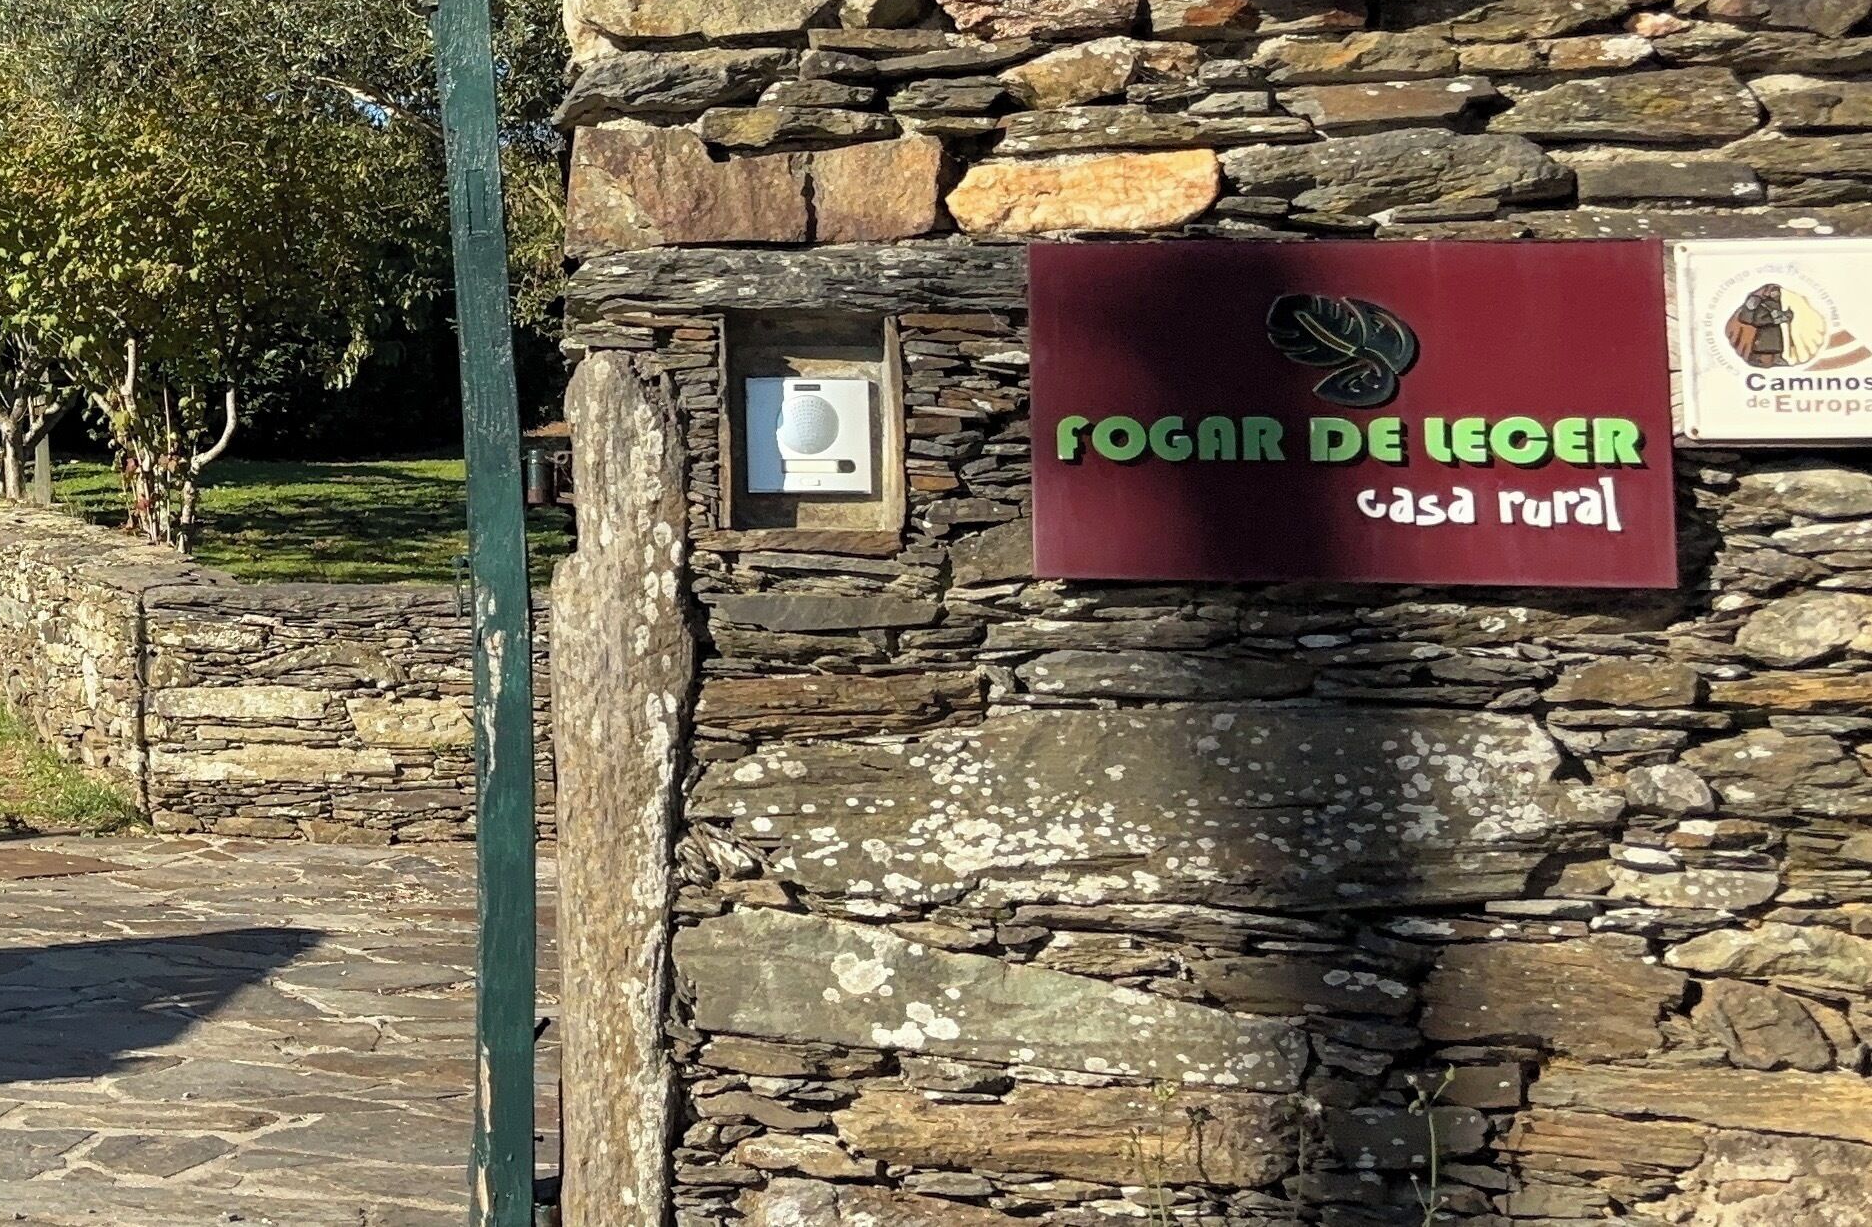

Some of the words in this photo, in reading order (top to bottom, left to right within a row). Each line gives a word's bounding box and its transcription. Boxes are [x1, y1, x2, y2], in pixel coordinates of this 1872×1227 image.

[1745, 372, 1872, 392] Caminos
[1745, 394, 1770, 409] de
[1056, 415, 1286, 462] FOGAR
[1309, 416, 1403, 463] DE
[1424, 415, 1643, 465] LECER
[1356, 486, 1476, 526] casa
[1497, 477, 1623, 532] rural
